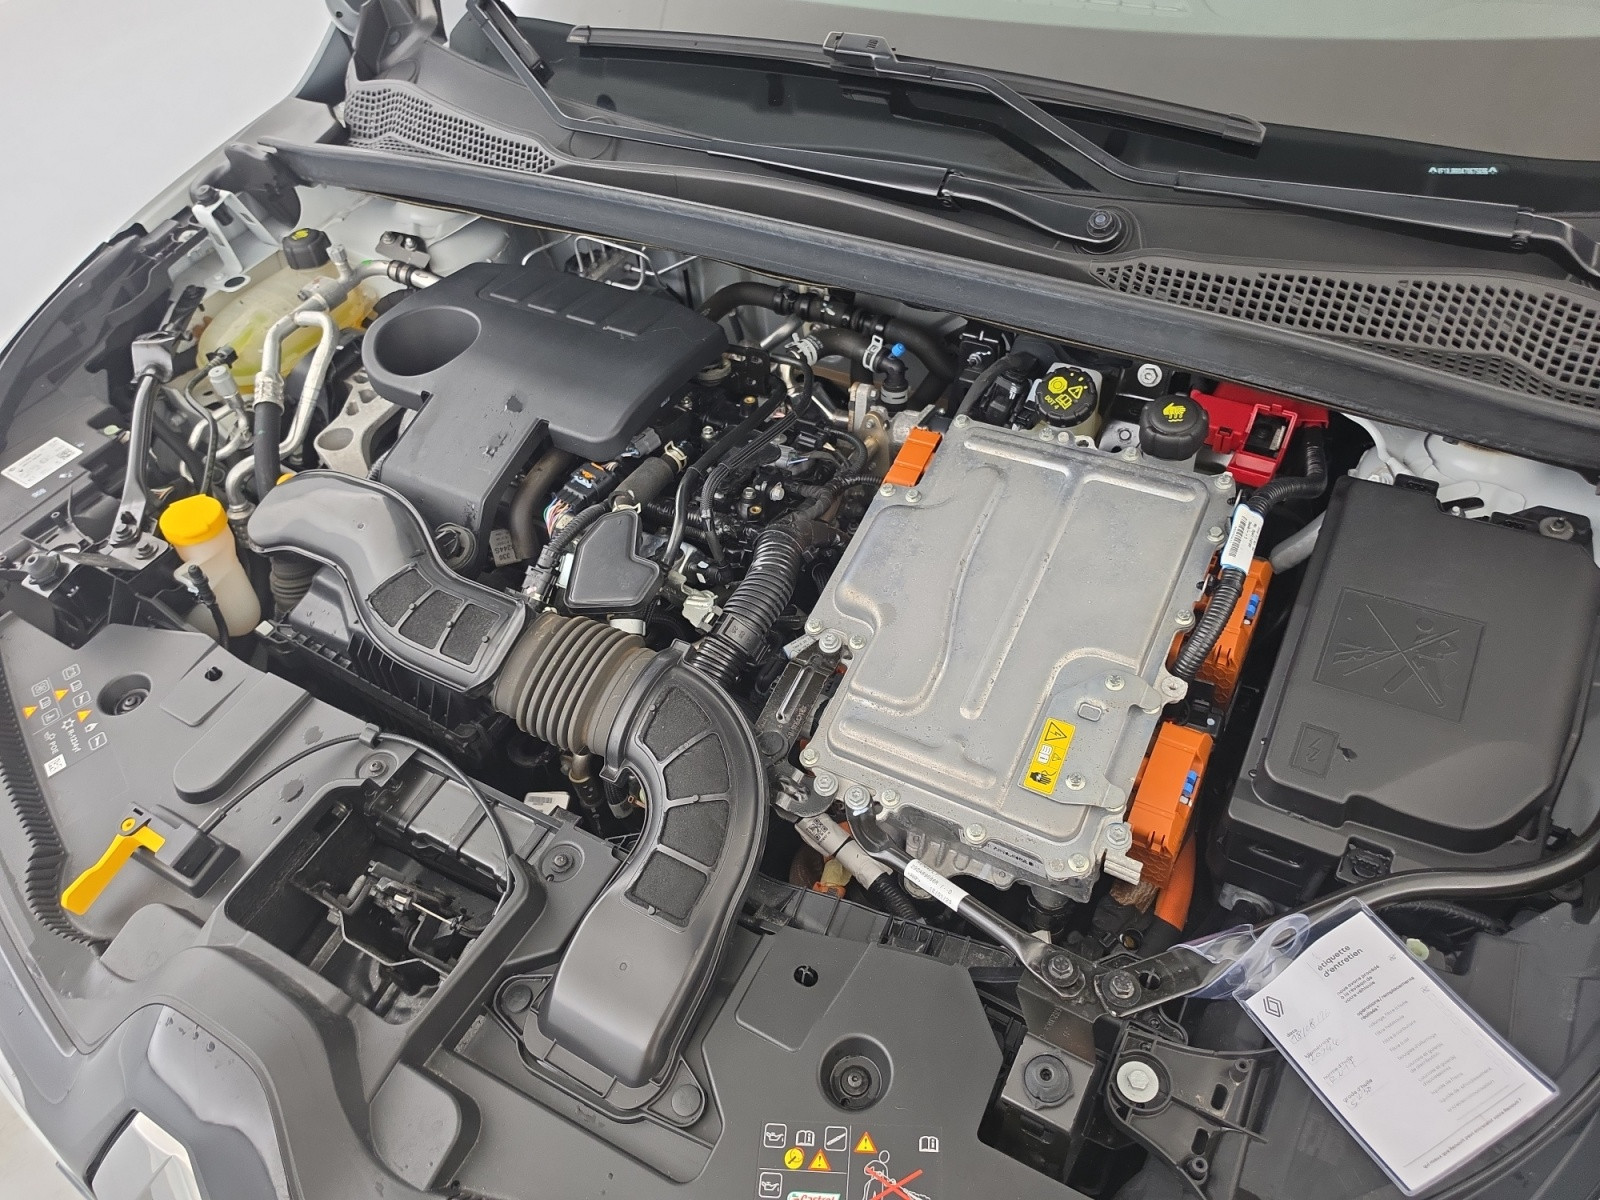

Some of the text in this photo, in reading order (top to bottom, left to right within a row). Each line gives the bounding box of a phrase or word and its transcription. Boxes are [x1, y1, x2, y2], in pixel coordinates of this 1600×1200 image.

[1044, 394, 1056, 406] DOT
[49, 740, 59, 754] POE
[67, 728, 82, 753] R-1234yf
[1317, 945, 1351, 971] étiquette
[1323, 948, 1363, 978] d'entretien
